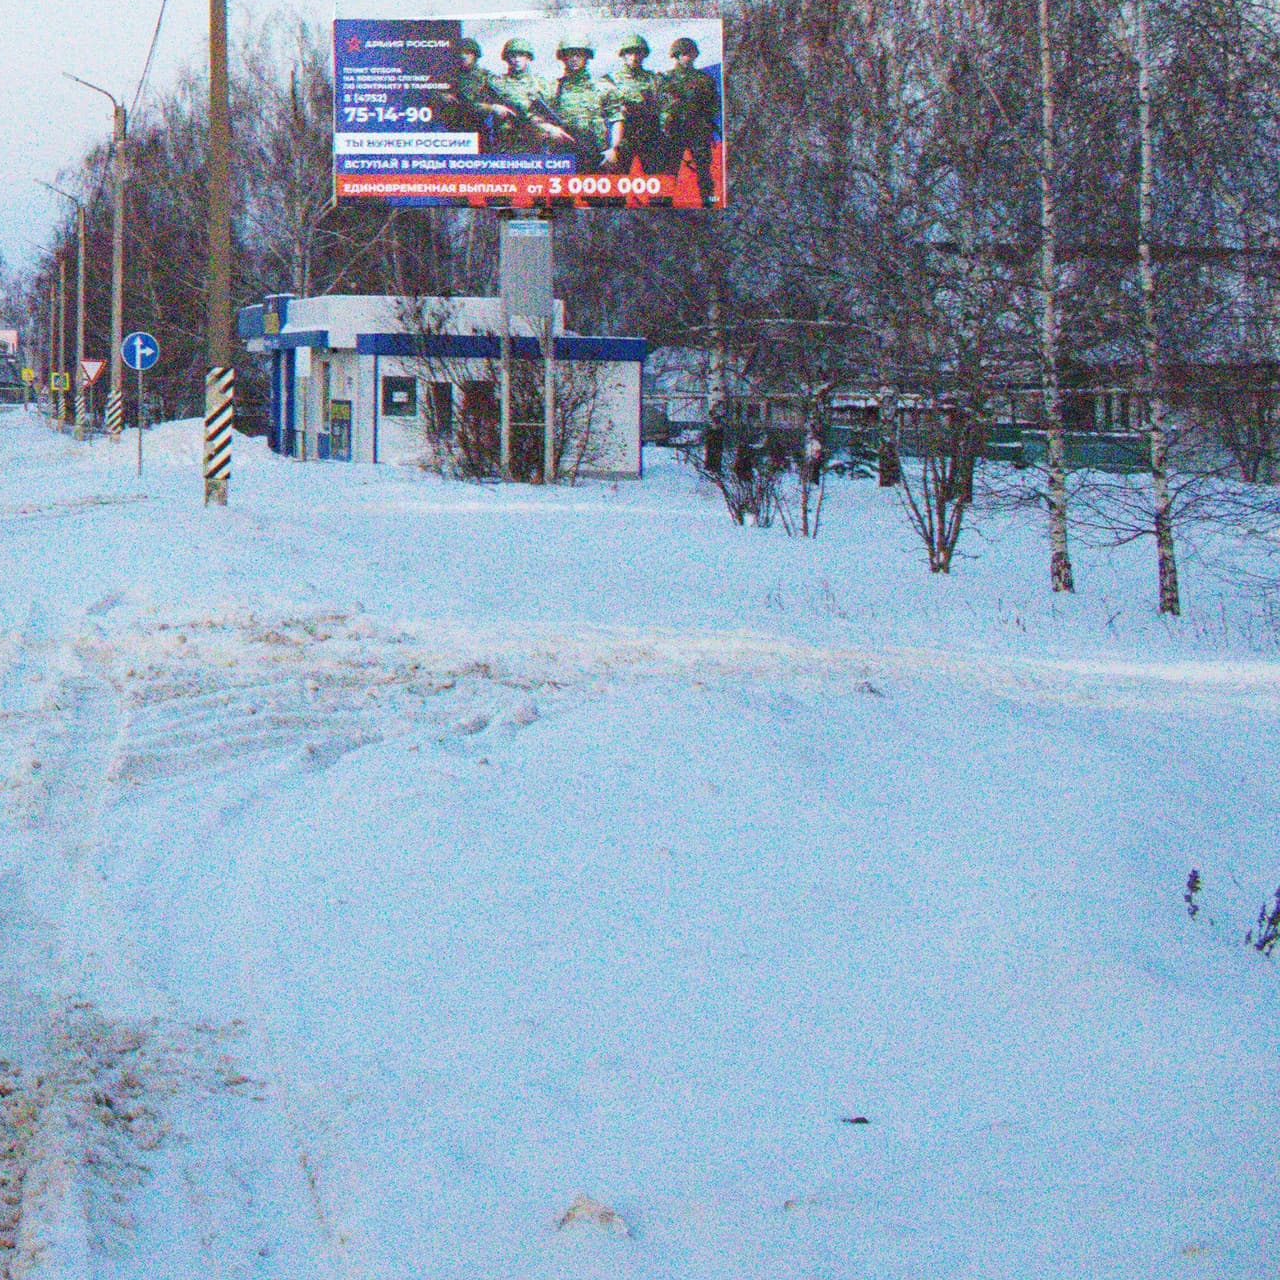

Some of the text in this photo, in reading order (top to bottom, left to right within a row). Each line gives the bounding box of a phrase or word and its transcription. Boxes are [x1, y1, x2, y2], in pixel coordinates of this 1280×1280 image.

[365, 39, 450, 49] АРМИЯ РОССИИ
[354, 93, 388, 104] (4752)
[343, 106, 432, 122] 75-14-90
[345, 139, 364, 148] ТЫ
[366, 139, 413, 148] НУЖЕН
[344, 158, 571, 170] ВСТУПАЙ В РЯДЫ ВООРУЖЕННЫХ СИЛ
[344, 183, 457, 194] ЕДИНОВРЕМЕННАЯ
[459, 184, 518, 193] ВЫПЛАТА
[548, 178, 562, 194] 3
[568, 178, 612, 194] 000
[617, 178, 661, 194] 000
